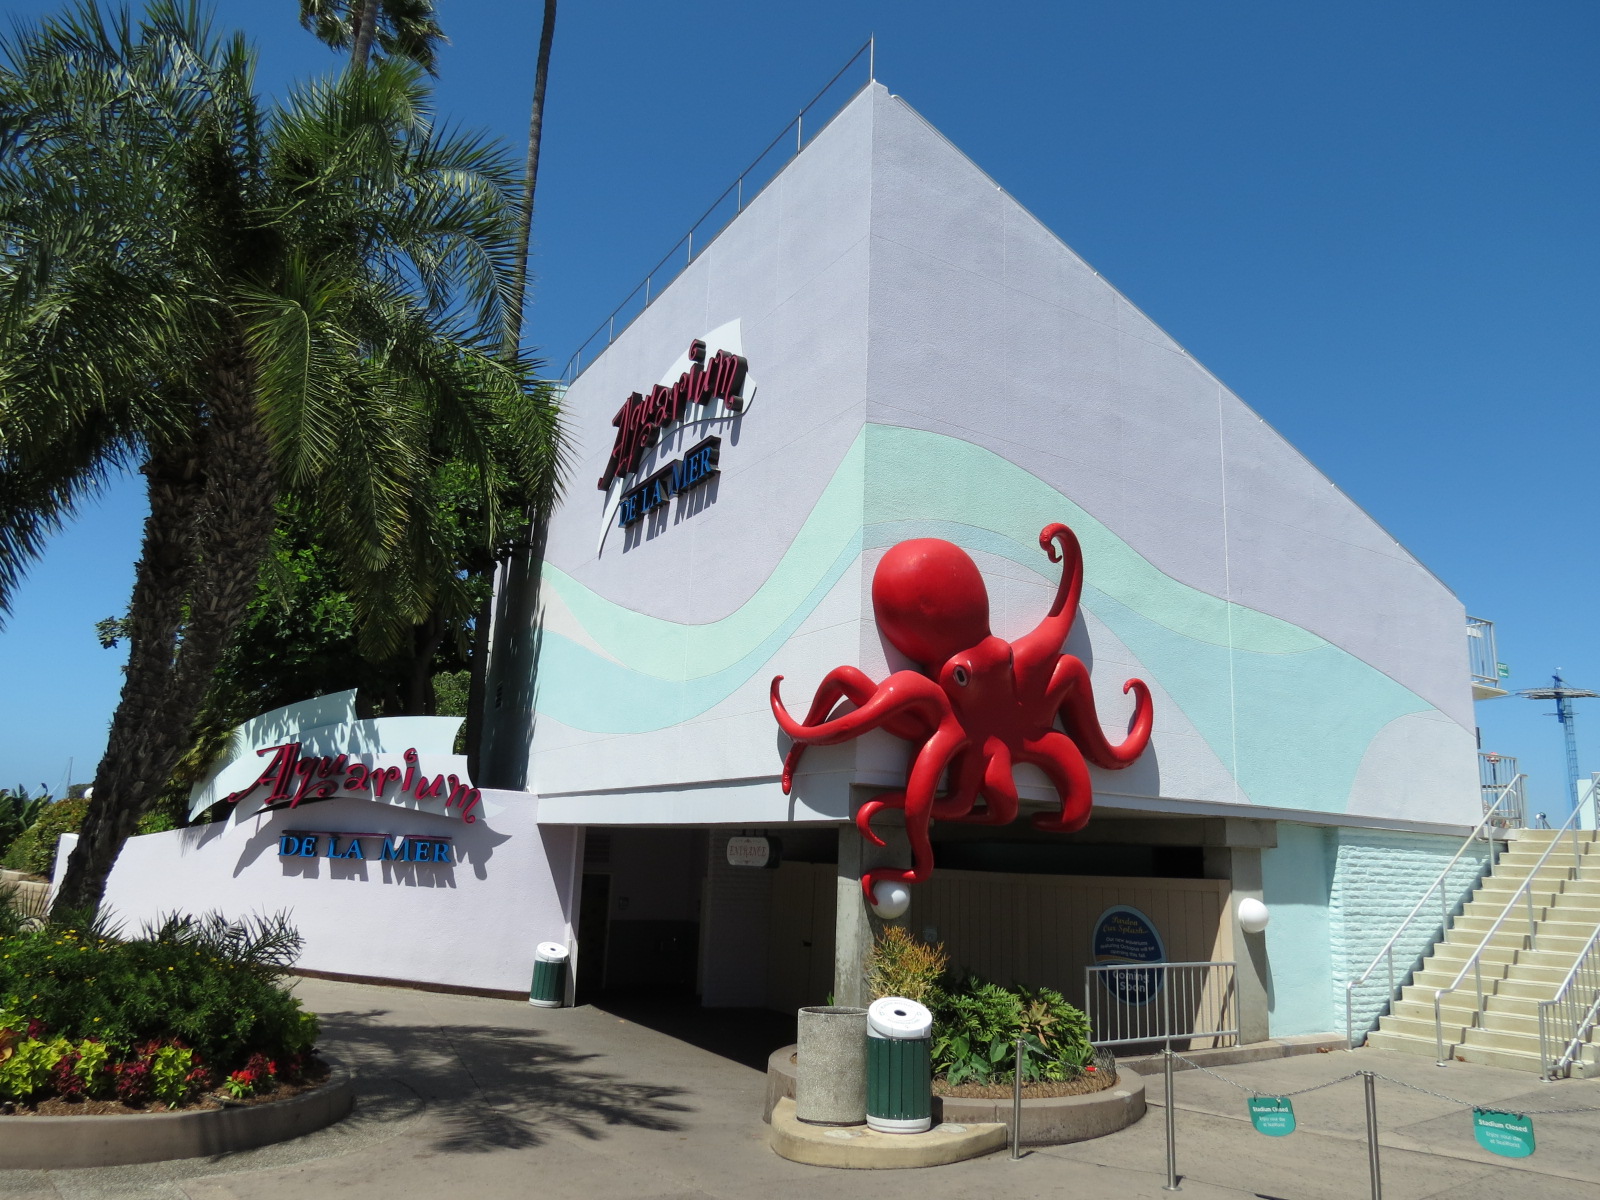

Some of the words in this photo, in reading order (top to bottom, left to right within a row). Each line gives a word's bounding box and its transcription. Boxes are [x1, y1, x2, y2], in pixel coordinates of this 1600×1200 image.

[597, 338, 748, 491] Aquarium
[618, 494, 638, 528] DE
[641, 478, 663, 512] LA
[668, 447, 714, 496] MER
[228, 741, 482, 824] Aquarium
[278, 835, 319, 858] DE
[326, 837, 365, 859] LA
[379, 836, 452, 864] MER
[729, 845, 767, 858] ENTRANCE
[1113, 971, 1149, 983] Coming
[1120, 982, 1145, 992] Soon
[1478, 1119, 1505, 1129] Stadium
[1505, 1123, 1529, 1133] Closed
